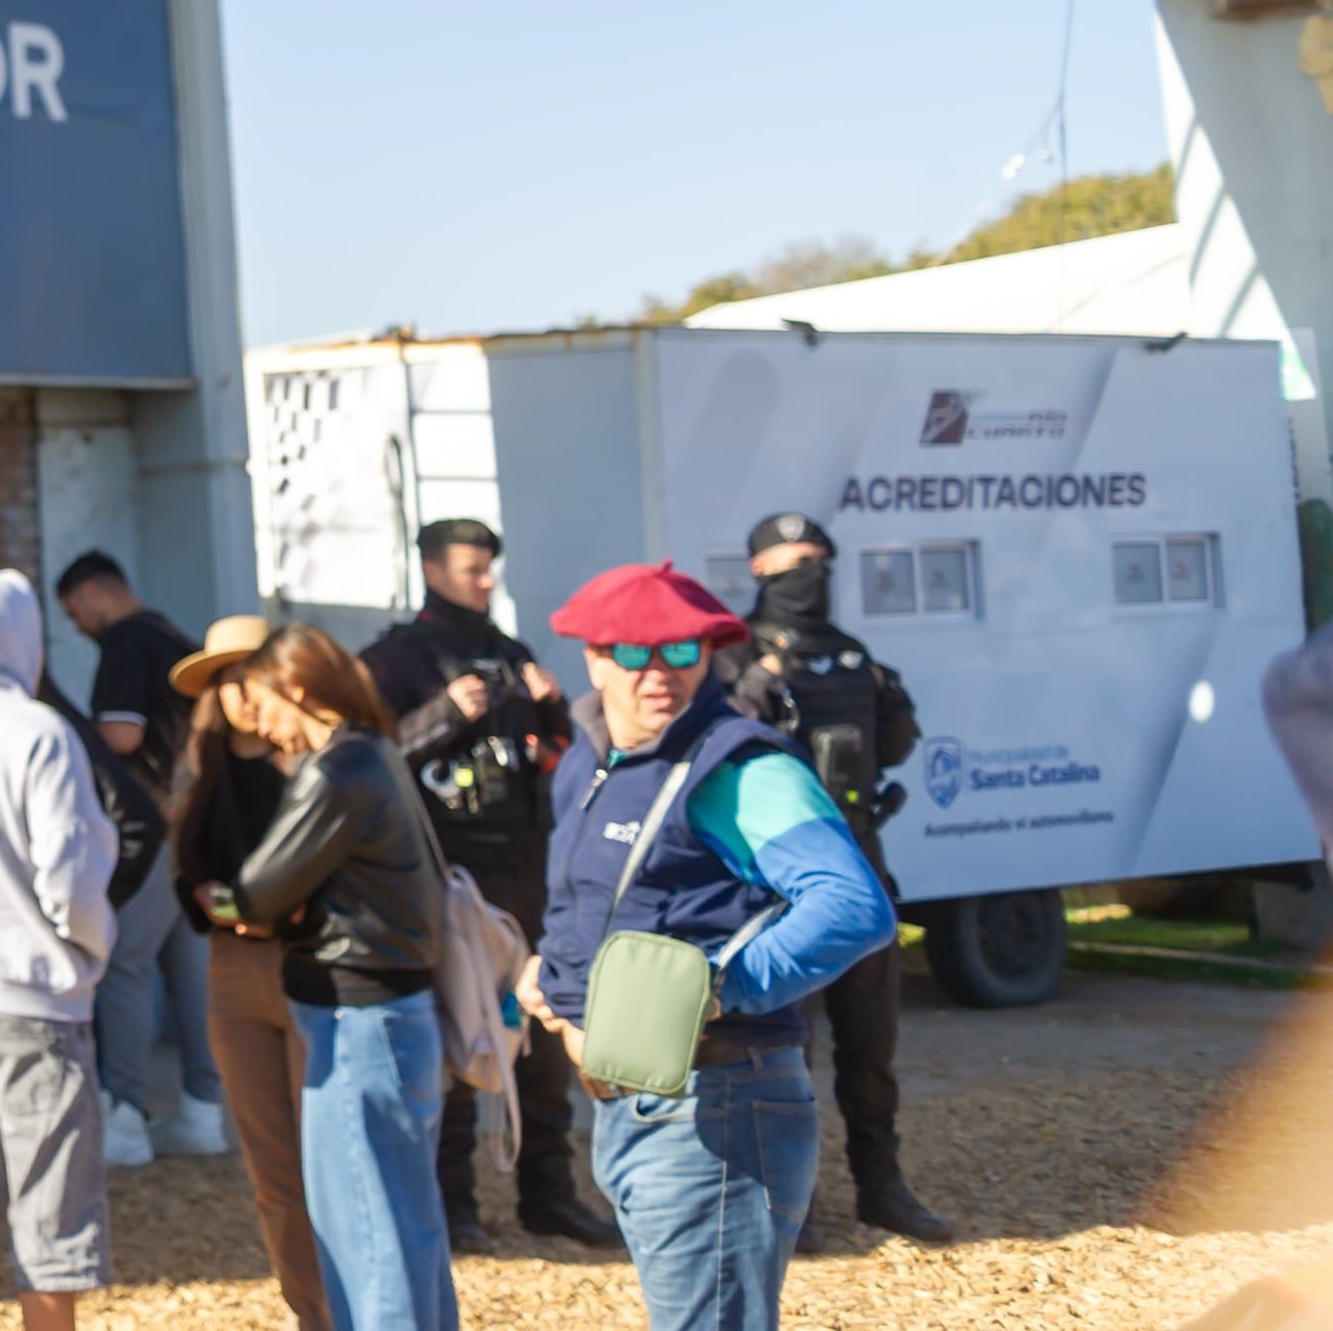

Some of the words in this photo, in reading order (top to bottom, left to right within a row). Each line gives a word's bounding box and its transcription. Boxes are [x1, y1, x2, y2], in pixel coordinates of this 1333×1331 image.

[838, 473, 1147, 512] ACREDITACIONES
[970, 768, 1025, 790] Santa
[1028, 761, 1100, 786] Catalina
